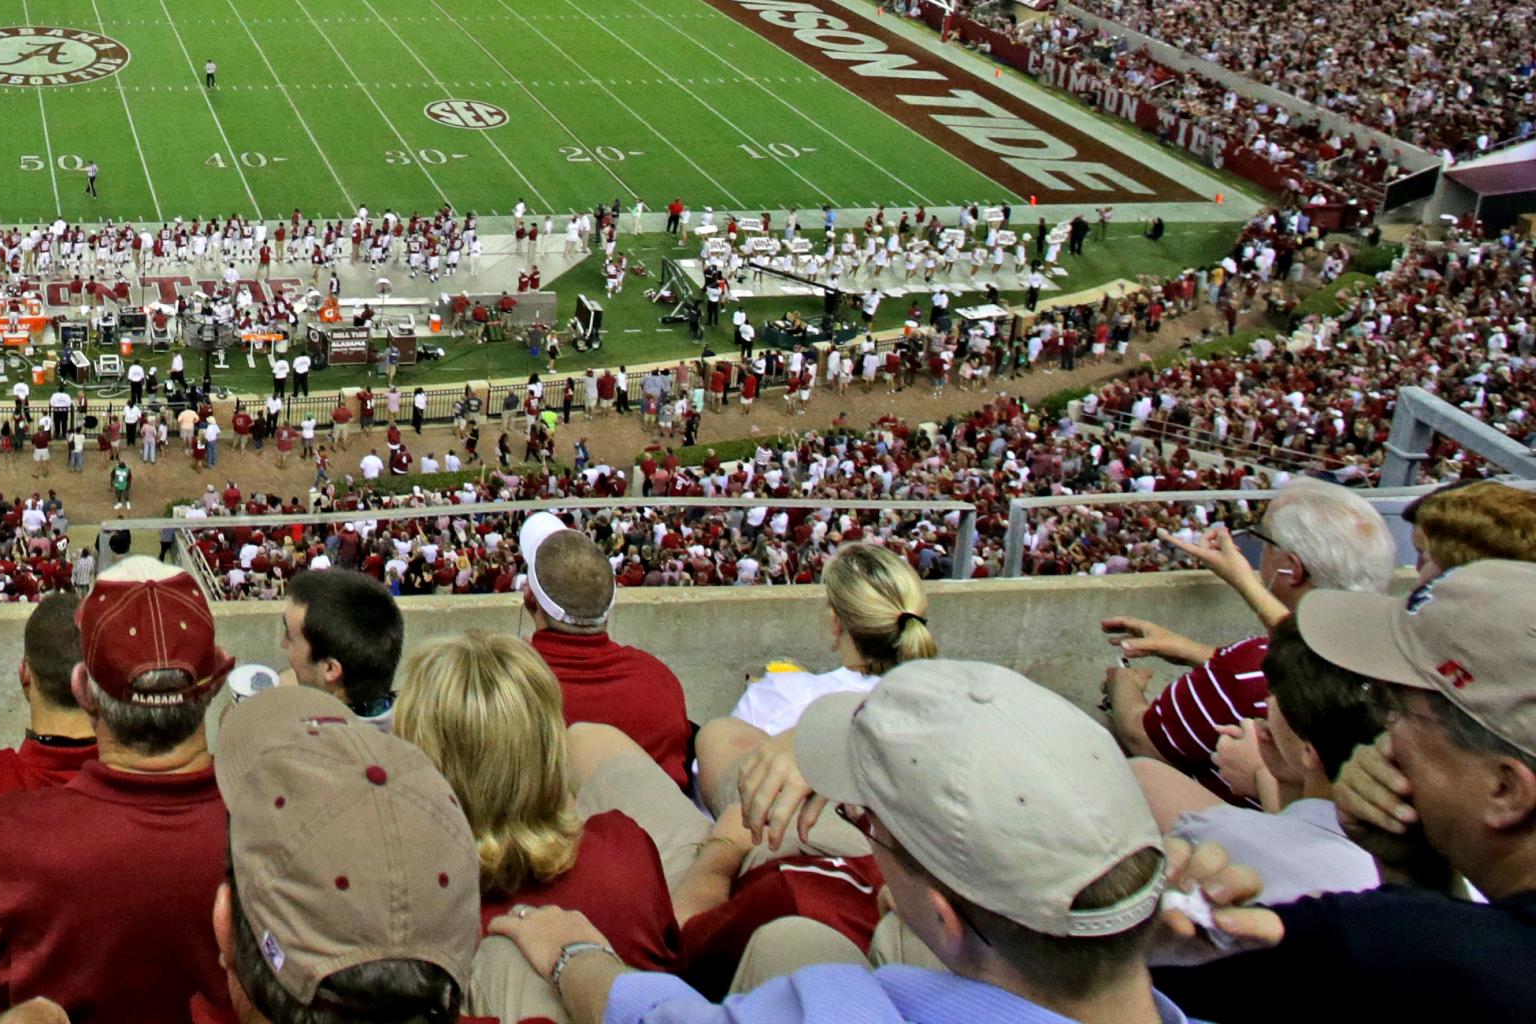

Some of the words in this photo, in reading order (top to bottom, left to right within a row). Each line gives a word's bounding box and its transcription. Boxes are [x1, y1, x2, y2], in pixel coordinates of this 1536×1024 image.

[70, 57, 123, 80] TIDE
[427, 101, 506, 127] SEC
[738, 142, 803, 159] 10
[896, 89, 1156, 195] TIDE
[19, 154, 86, 172] 50
[203, 152, 268, 168] 40
[384, 149, 449, 166] 30
[559, 146, 627, 163] 20
[131, 692, 184, 704] ALABAMA
